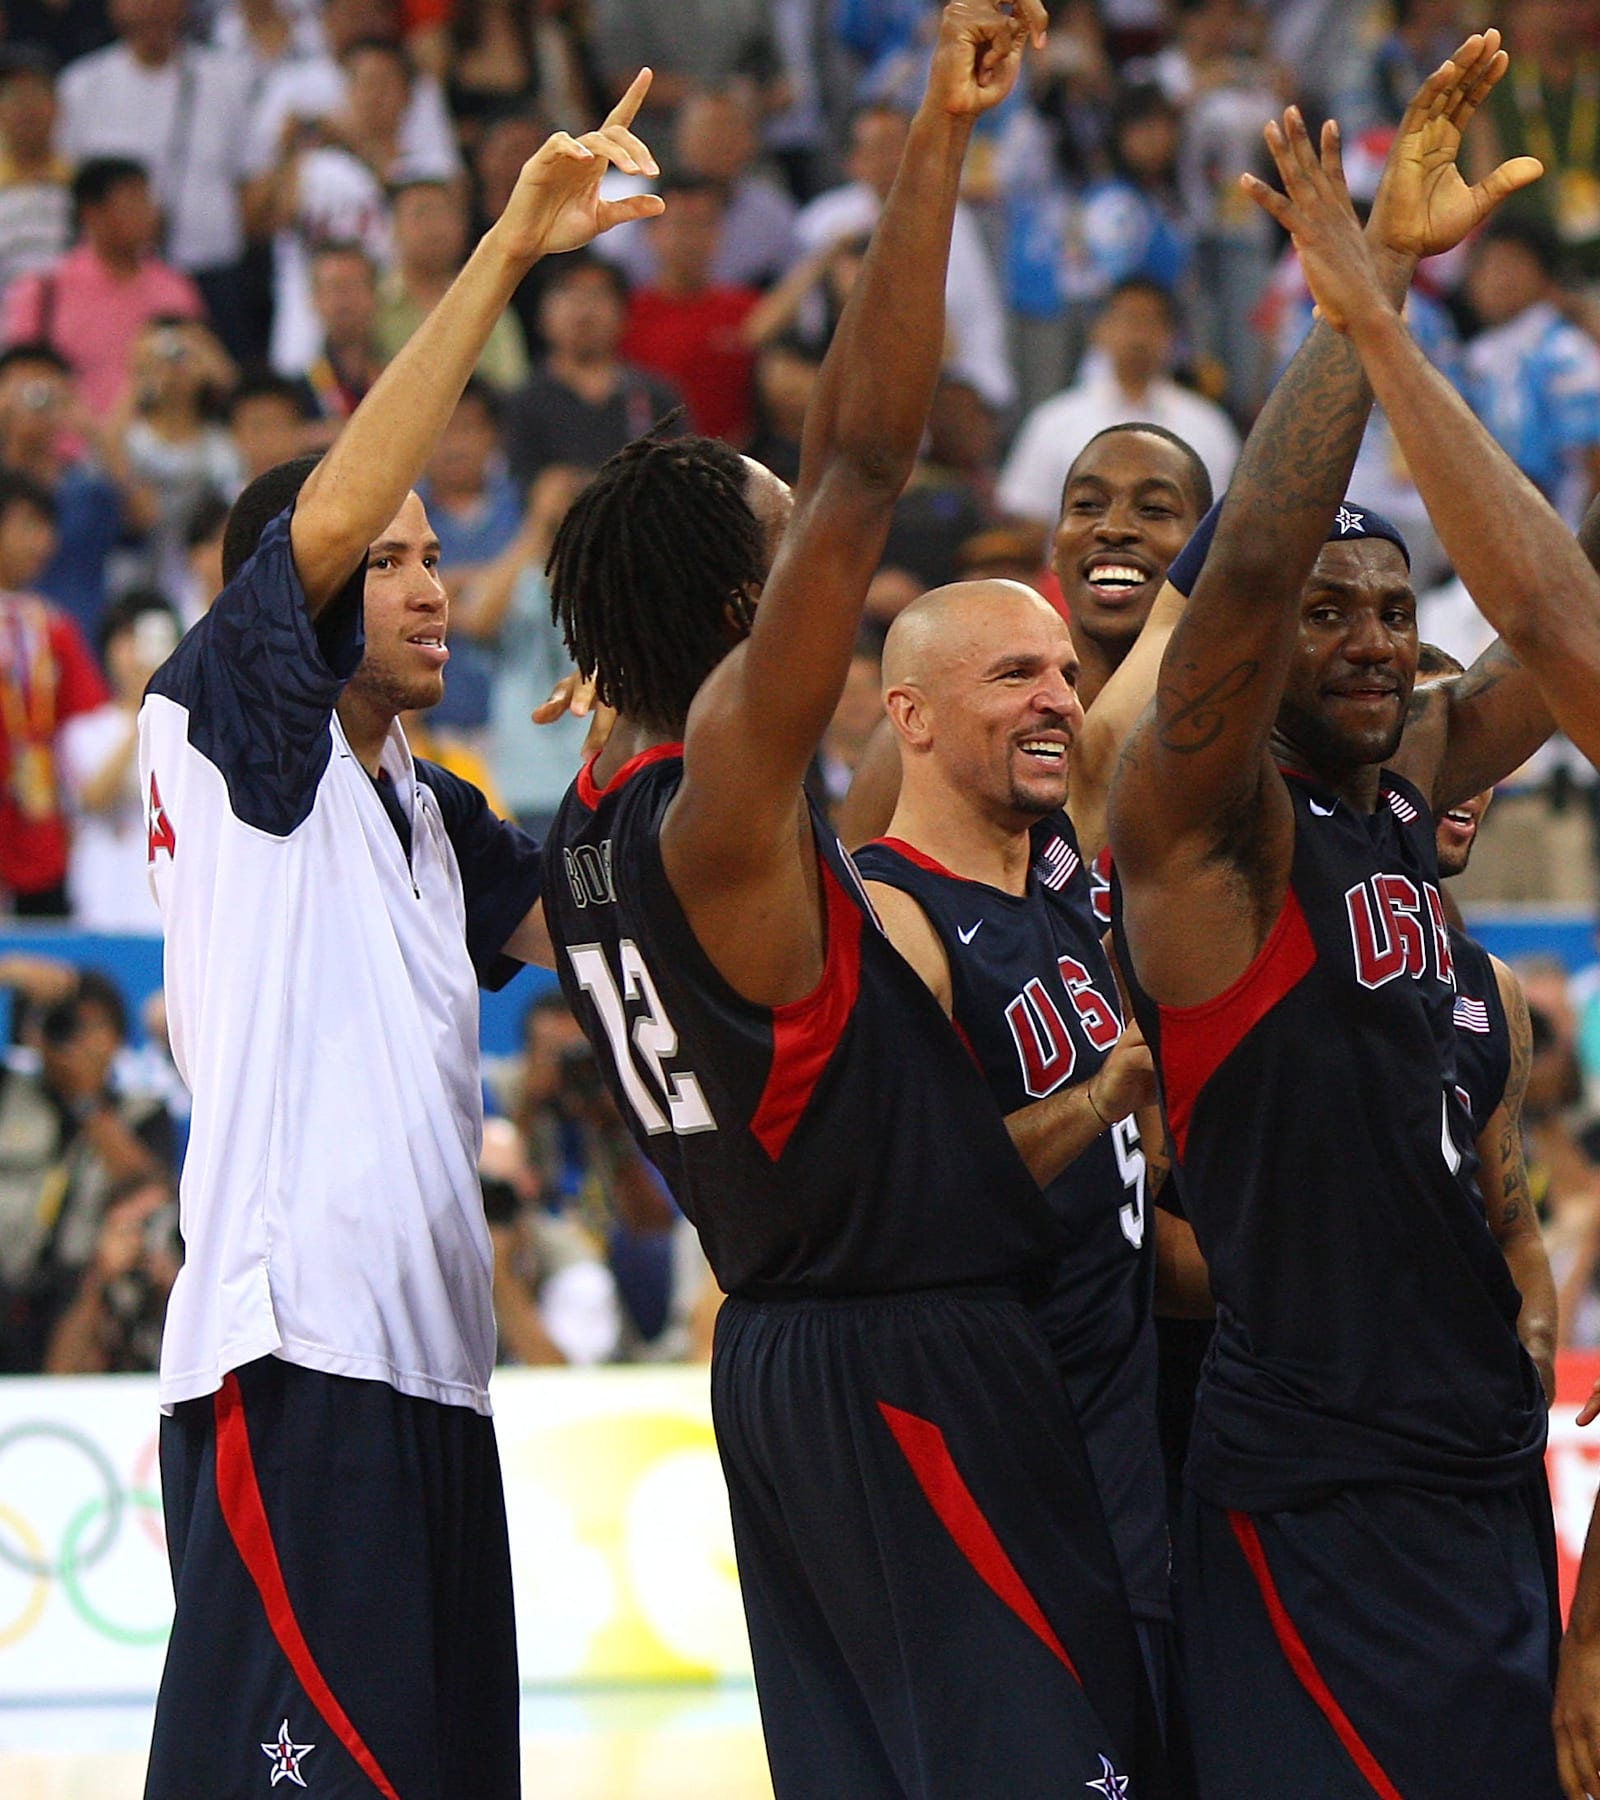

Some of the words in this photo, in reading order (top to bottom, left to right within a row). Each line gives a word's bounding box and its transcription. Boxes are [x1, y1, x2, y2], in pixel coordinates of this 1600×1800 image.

[565, 938, 719, 1136] 12
[1004, 939, 1125, 1098] US
[1111, 1112, 1147, 1250] 5
